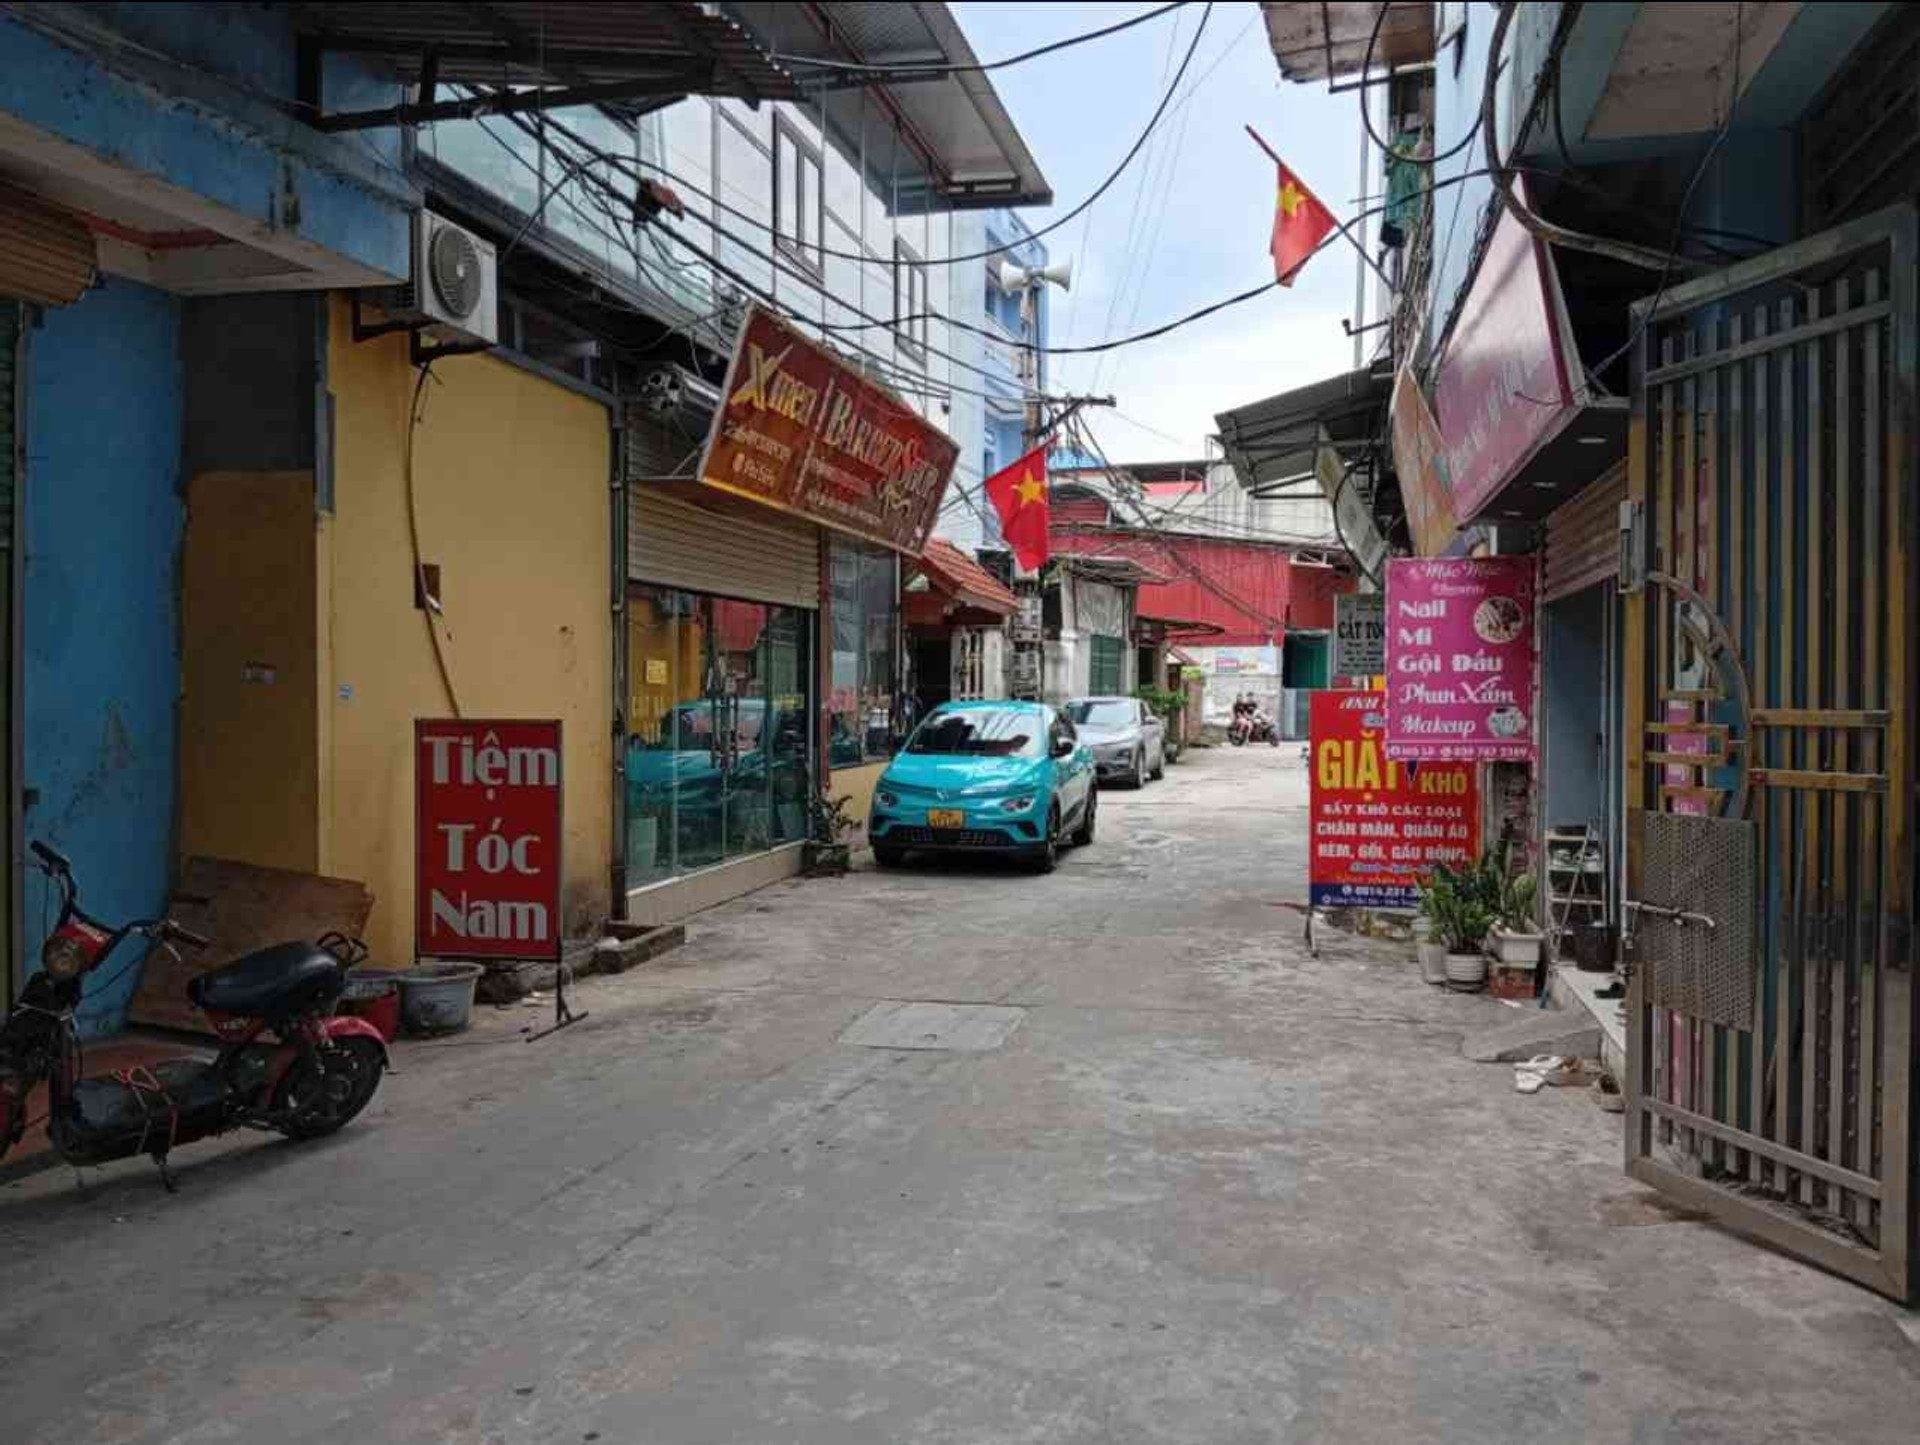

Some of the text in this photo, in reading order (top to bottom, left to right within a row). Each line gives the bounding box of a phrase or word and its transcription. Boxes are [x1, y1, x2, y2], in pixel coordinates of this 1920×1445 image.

[1398, 599, 1447, 618] Nail
[1397, 653, 1442, 677] Gội
[1452, 648, 1503, 672] Đầu
[1400, 713, 1476, 740] Makeup
[421, 729, 559, 801] Tiệm
[1420, 768, 1468, 794] KHÔ
[1356, 802, 1389, 816] KHÔ
[1392, 802, 1422, 816] CÁC
[1448, 822, 1467, 839] ÁO
[437, 817, 542, 875] Tóc
[431, 887, 548, 941] Nam
